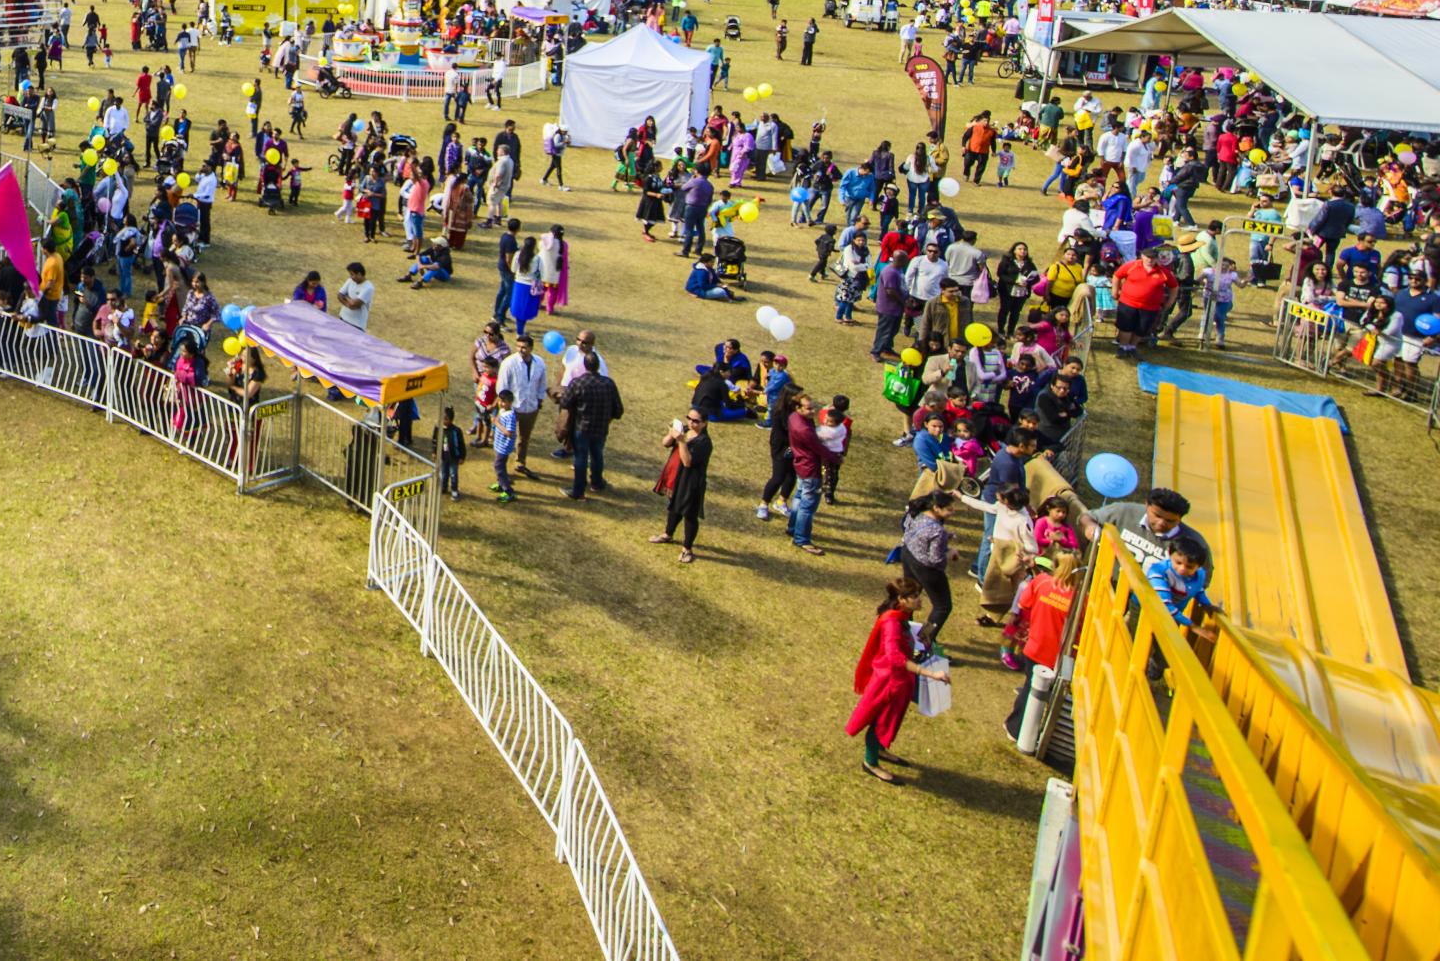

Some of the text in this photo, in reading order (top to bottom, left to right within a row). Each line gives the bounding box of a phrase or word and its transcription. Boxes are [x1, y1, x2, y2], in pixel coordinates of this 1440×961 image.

[915, 71, 937, 79] FREE
[1088, 72, 1107, 80] ATM
[1244, 220, 1282, 235] EXIT
[1292, 303, 1325, 323] EXIT
[405, 375, 427, 392] EXIT
[257, 399, 289, 418] ENTRANCE
[393, 481, 424, 501] EXIT
